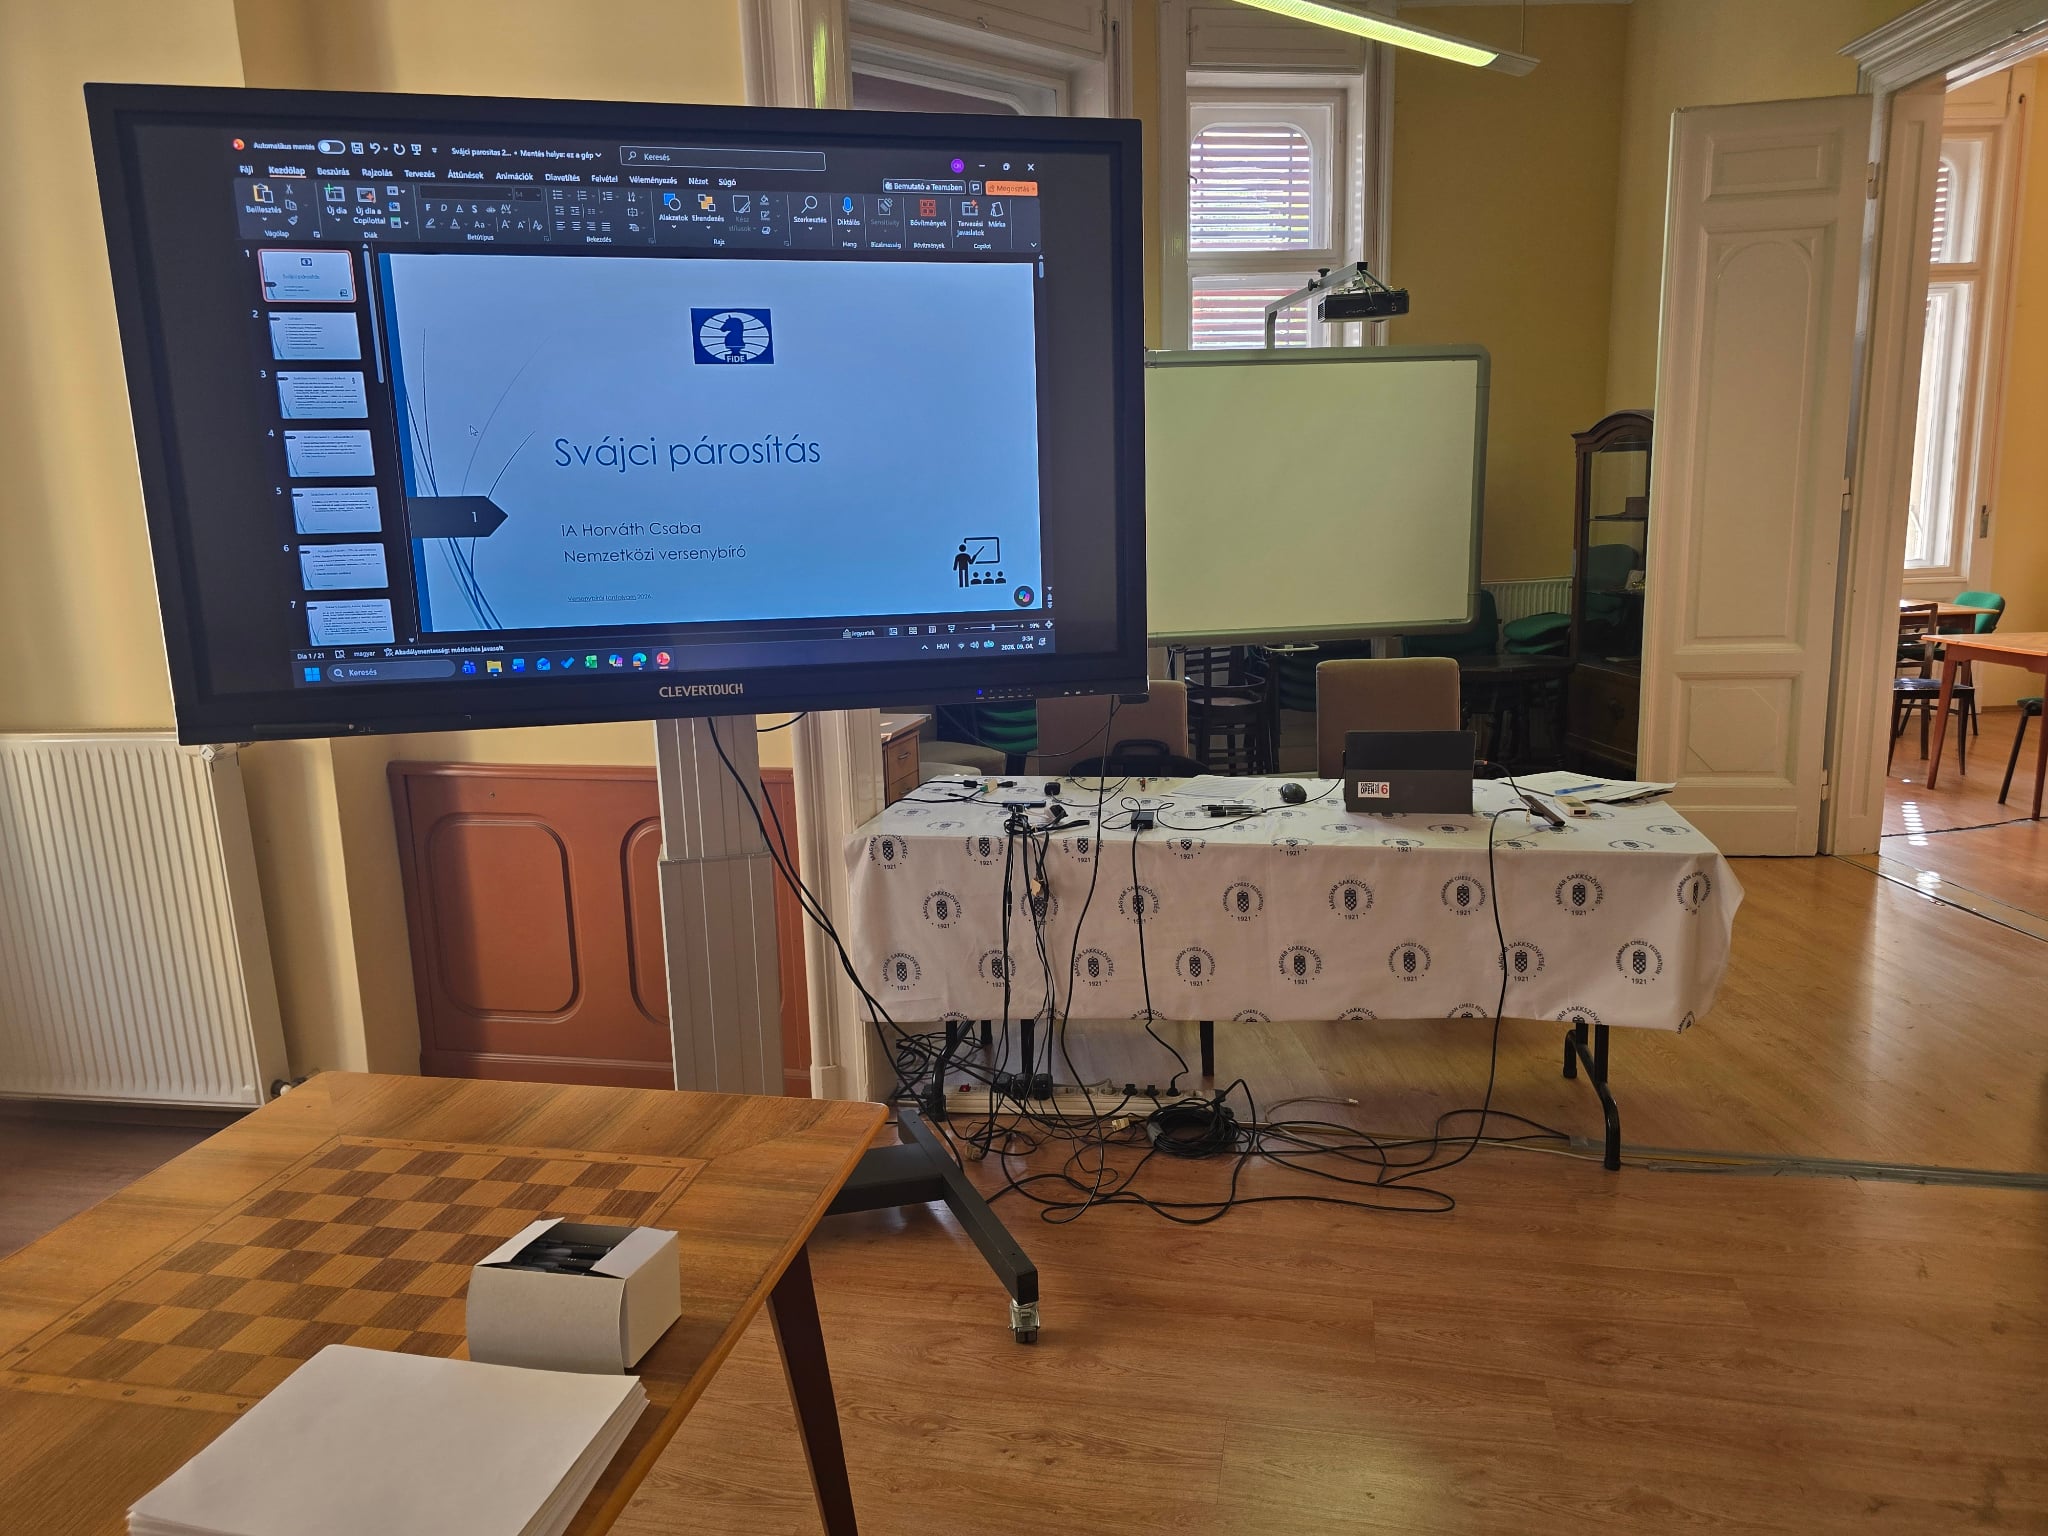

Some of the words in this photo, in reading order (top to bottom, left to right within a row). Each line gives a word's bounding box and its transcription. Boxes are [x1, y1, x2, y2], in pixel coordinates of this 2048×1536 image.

[452, 147, 470, 157] Svájci
[644, 153, 670, 161] Keresés
[317, 167, 350, 176] Beszúrás
[362, 168, 393, 178] Rajzolás
[404, 170, 436, 178] Tervezés
[496, 172, 534, 181] Animációk
[591, 174, 619, 183] Felvétel
[688, 177, 709, 185] Nézet
[718, 178, 737, 188] Súgó
[894, 182, 925, 191] Bemutató
[996, 185, 1030, 194] Megosztás
[245, 205, 282, 214] Beillesztés
[336, 206, 348, 214] dia
[366, 207, 376, 215] dia
[354, 217, 386, 226] Copilottal
[245, 249, 251, 258] 1
[253, 310, 260, 319] 2
[726, 355, 746, 364] FIDE
[260, 369, 267, 379] 3
[267, 429, 275, 438] 4
[554, 436, 658, 473] Svájci
[669, 433, 821, 472] párosítás
[275, 486, 282, 495] 5
[471, 511, 477, 523] 1
[560, 524, 578, 537] IA
[582, 522, 645, 537] Horváth
[649, 521, 702, 535] Csaba
[283, 544, 290, 552] 6
[563, 547, 655, 563] Nemzetközi
[658, 543, 748, 564] versenybíró
[290, 600, 297, 609] 7
[936, 643, 950, 651] HUN
[348, 668, 378, 677] Keresés
[659, 683, 744, 698] CLEVERTOUCH
[1381, 784, 1388, 795] 6
